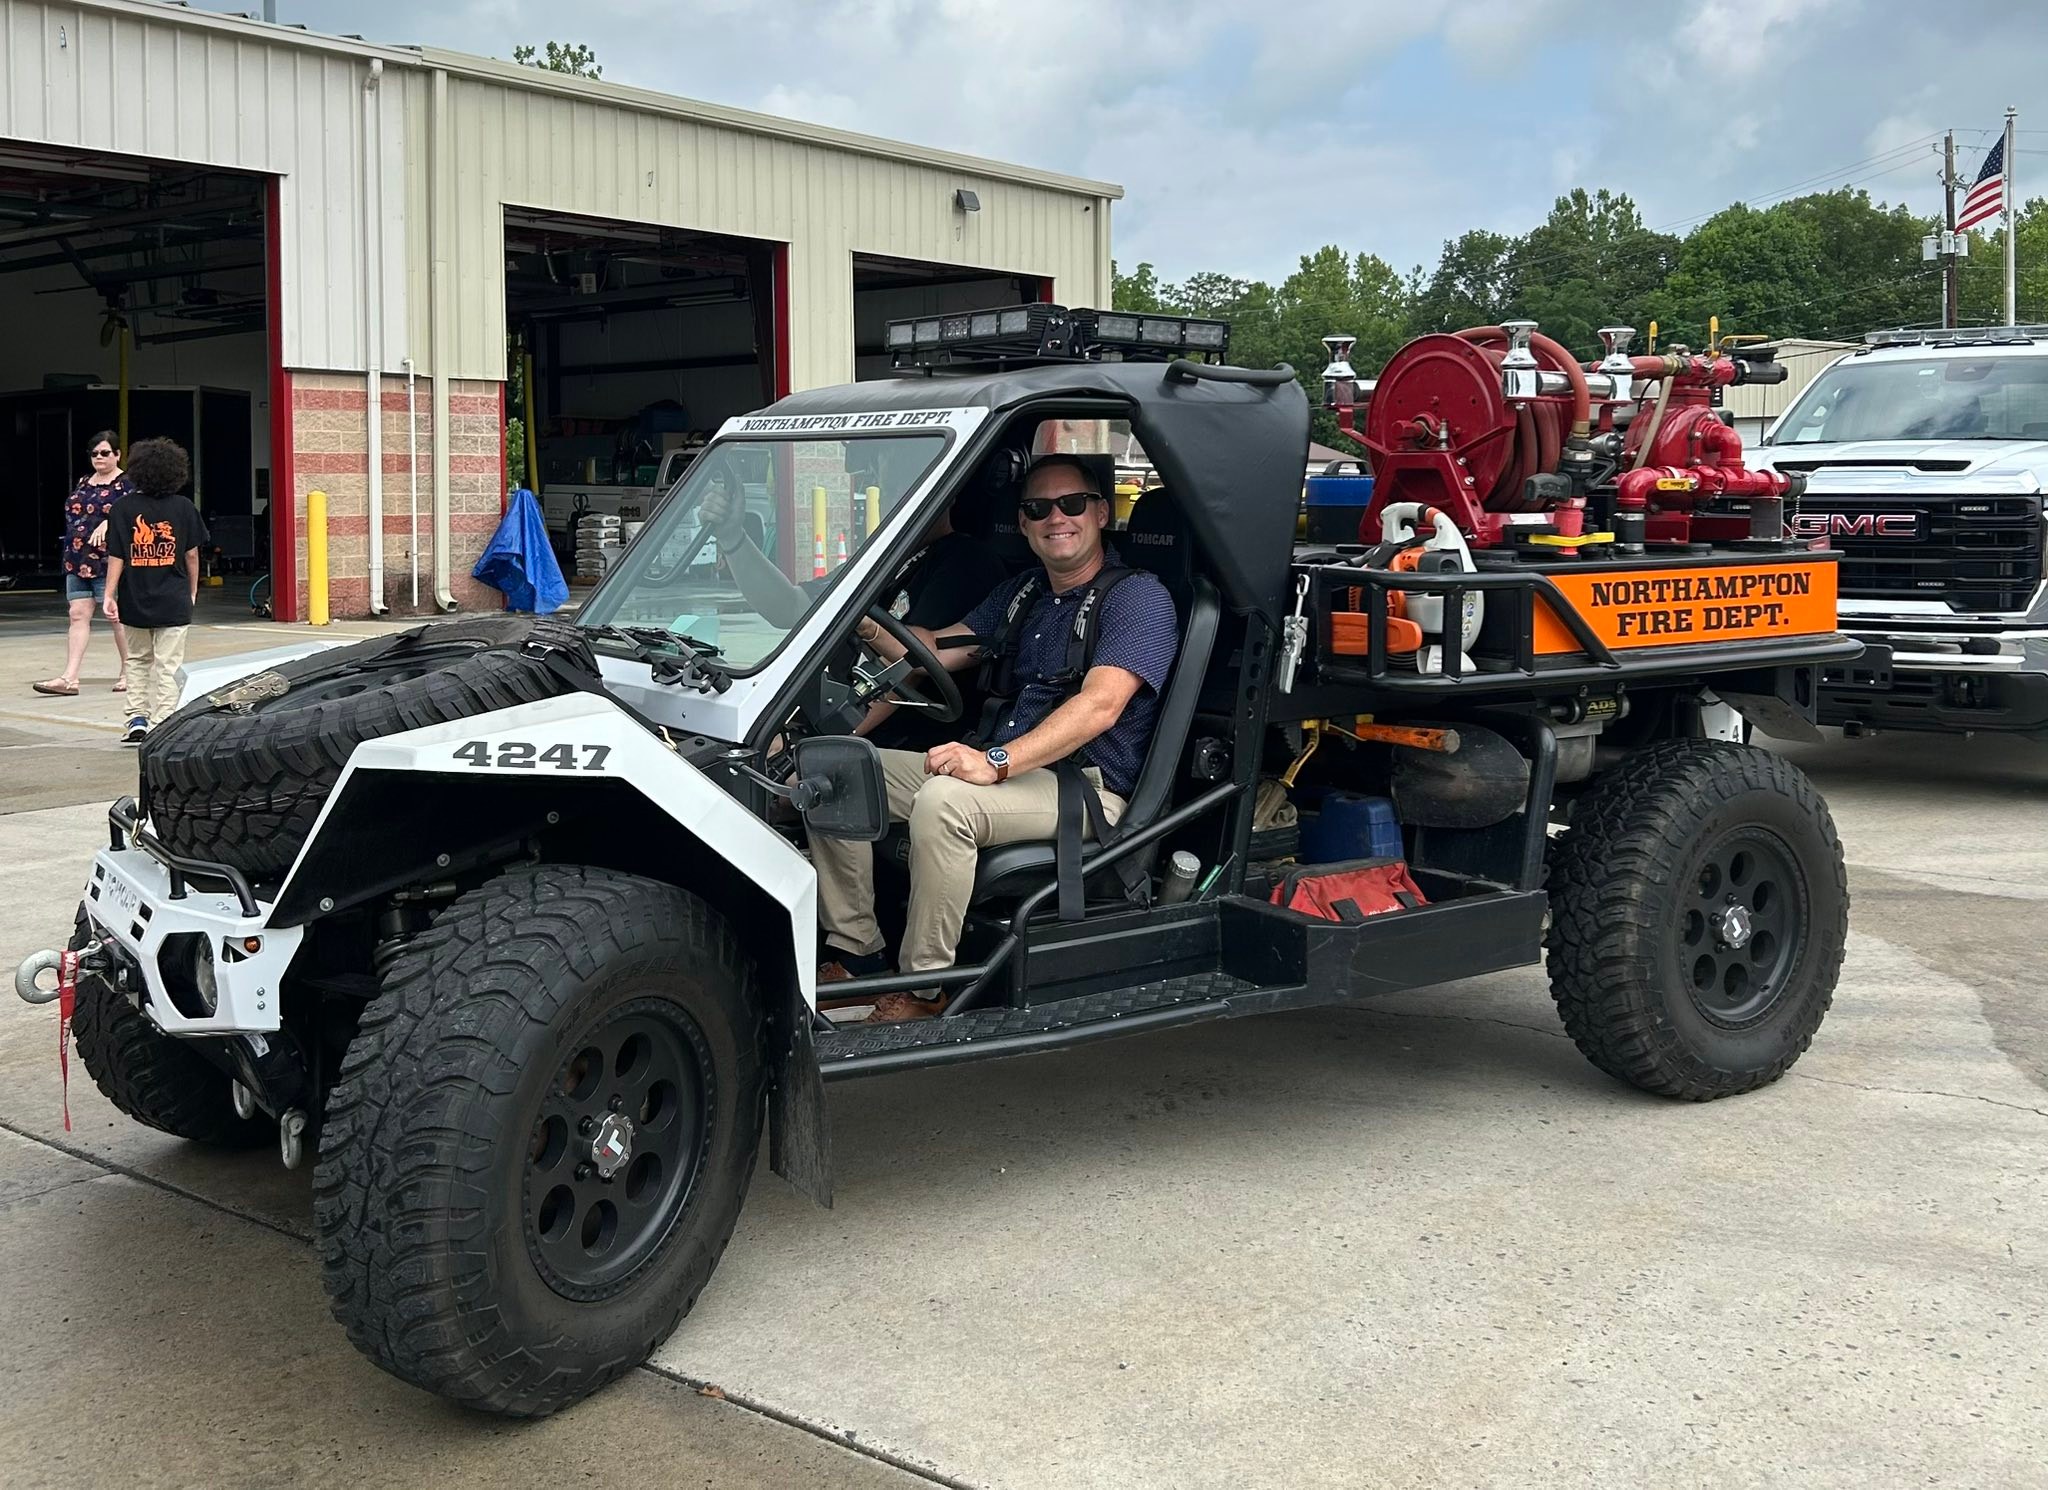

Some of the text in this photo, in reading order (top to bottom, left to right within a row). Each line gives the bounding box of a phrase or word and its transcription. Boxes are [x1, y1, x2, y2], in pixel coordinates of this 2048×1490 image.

[739, 410, 952, 431] NORTHAMPTON FIRE DEPT.
[1791, 514, 1916, 536] GMC
[131, 542, 176, 558] NFD 42
[1131, 532, 1175, 546] TOMCAR
[1591, 572, 1811, 606] NORTHAMPTON
[1617, 603, 1789, 637] FIRE DEPT.
[452, 740, 612, 771] 4247
